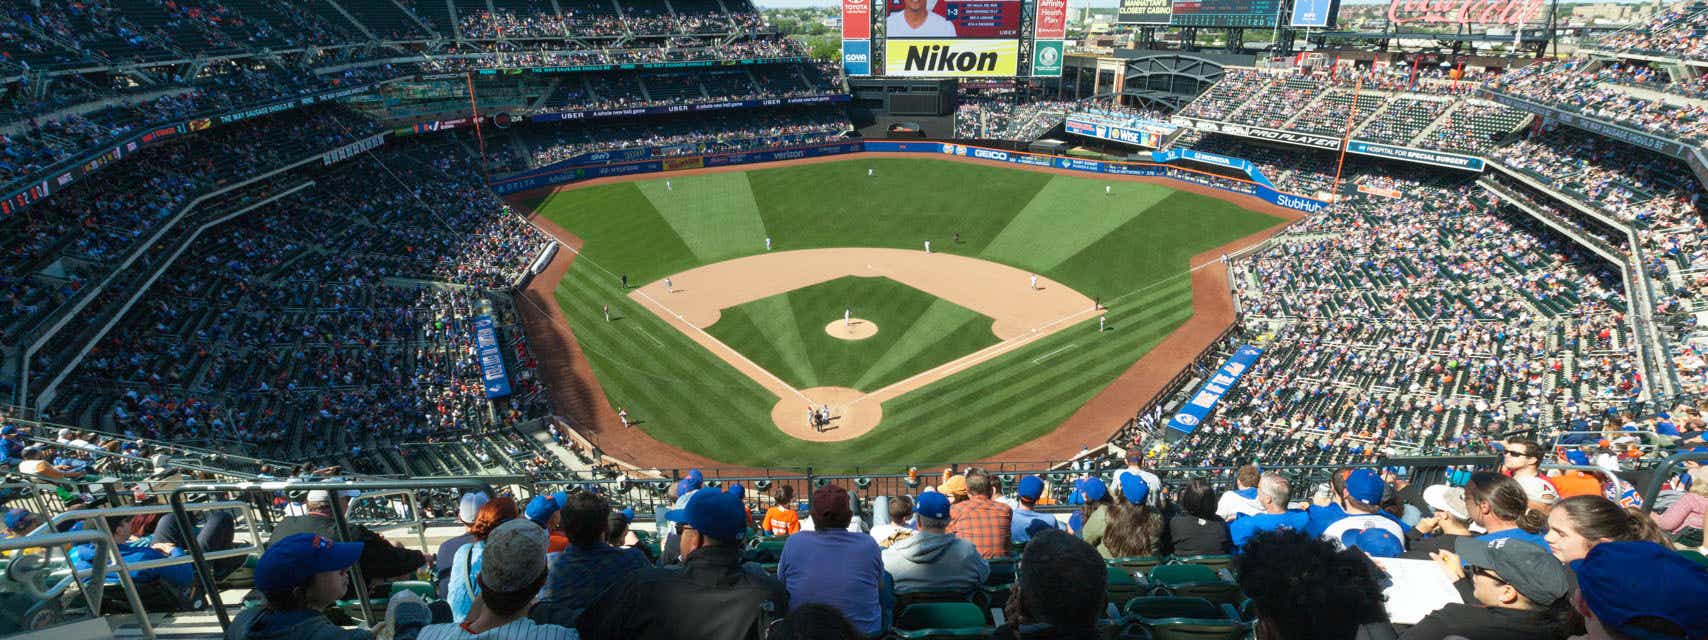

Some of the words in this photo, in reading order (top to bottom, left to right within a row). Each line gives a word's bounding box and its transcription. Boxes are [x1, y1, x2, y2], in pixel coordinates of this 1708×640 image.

[904, 45, 998, 71] Nikon
[1120, 129, 1139, 143] WISE
[1250, 130, 1279, 138] PRO
[1278, 134, 1338, 147] PLAYER
[774, 151, 804, 160] verizon
[974, 149, 1007, 160] GEICO
[1200, 154, 1230, 164] HONDA
[1408, 152, 1434, 160] SPECIAL
[1436, 155, 1469, 165] SURGERY
[1277, 194, 1321, 212] StubHub
